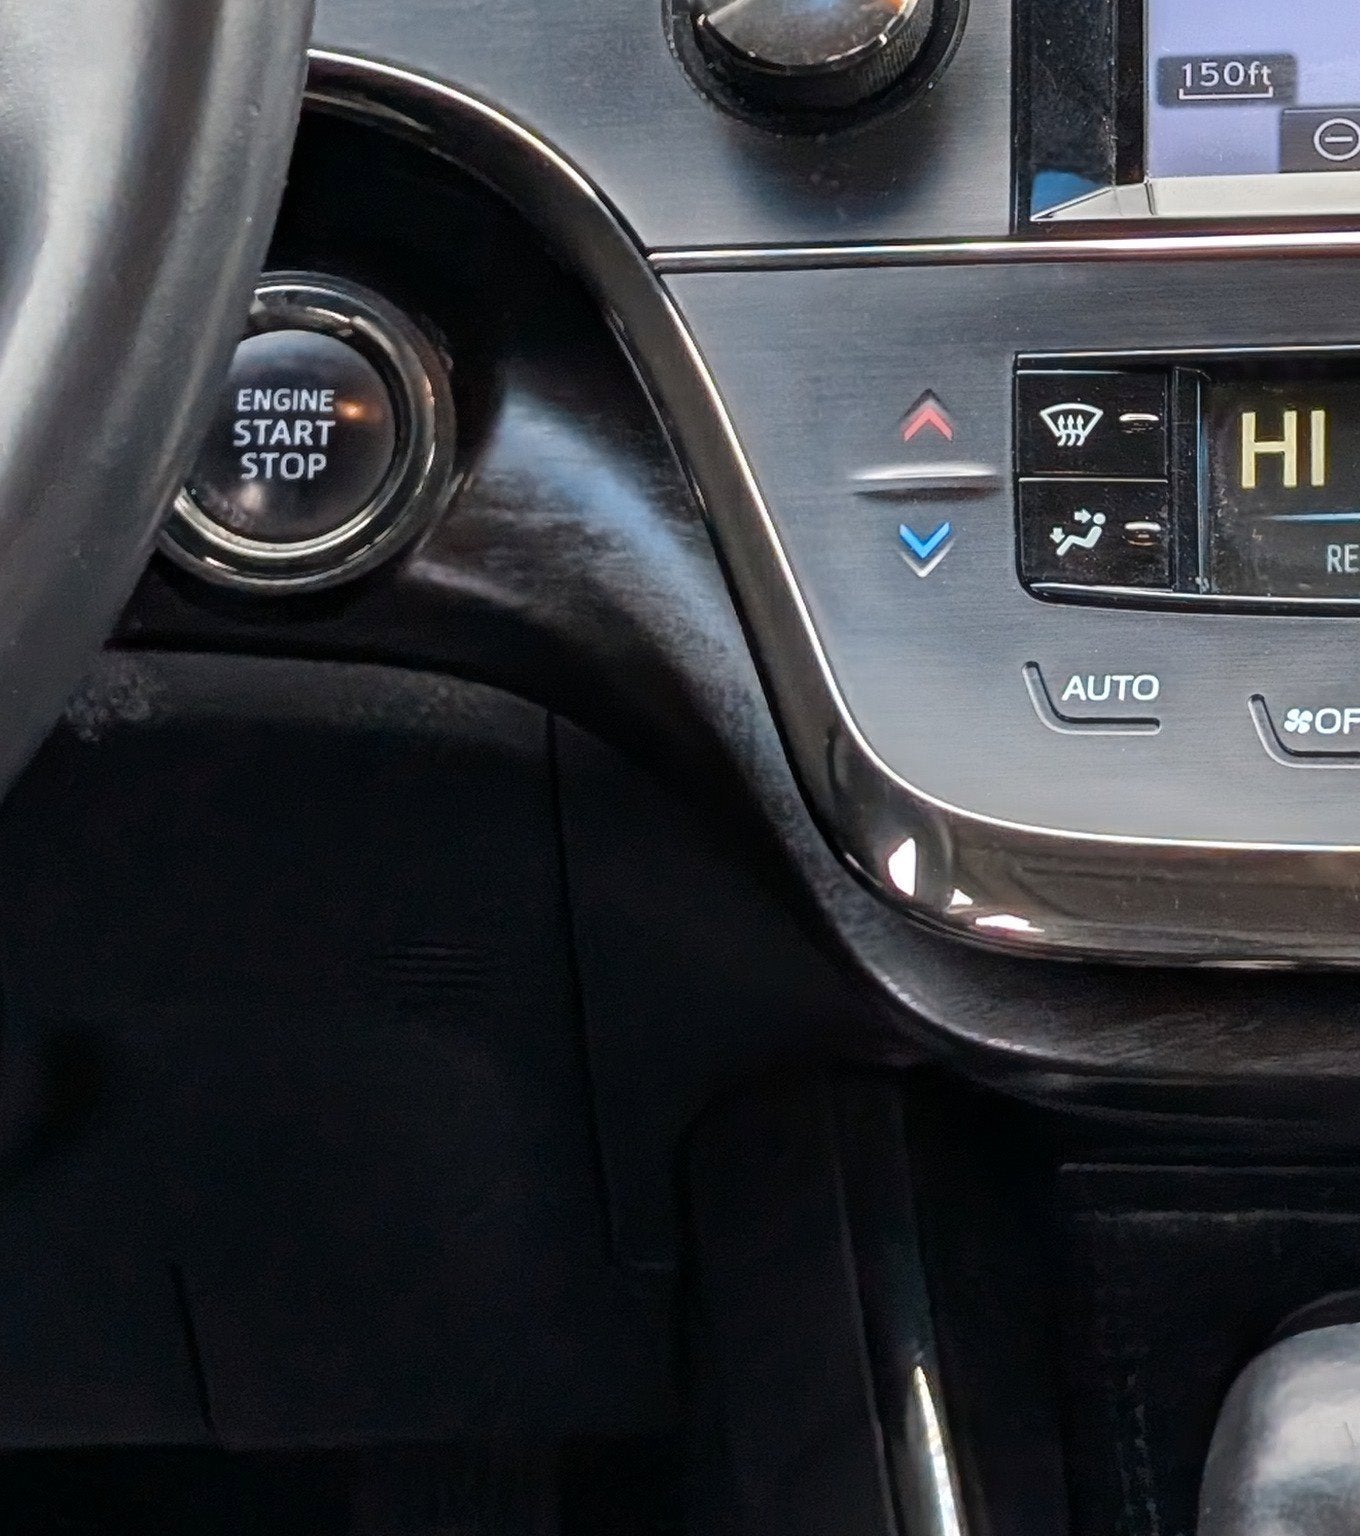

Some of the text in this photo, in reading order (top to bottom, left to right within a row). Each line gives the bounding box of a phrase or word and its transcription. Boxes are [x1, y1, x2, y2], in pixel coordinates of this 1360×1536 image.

[1181, 60, 1273, 88] 150ft
[235, 387, 336, 413] ENGINE
[232, 418, 337, 448] START
[1240, 408, 1327, 489] HI
[239, 452, 328, 482] STOP
[1061, 673, 1161, 702] AUTO
